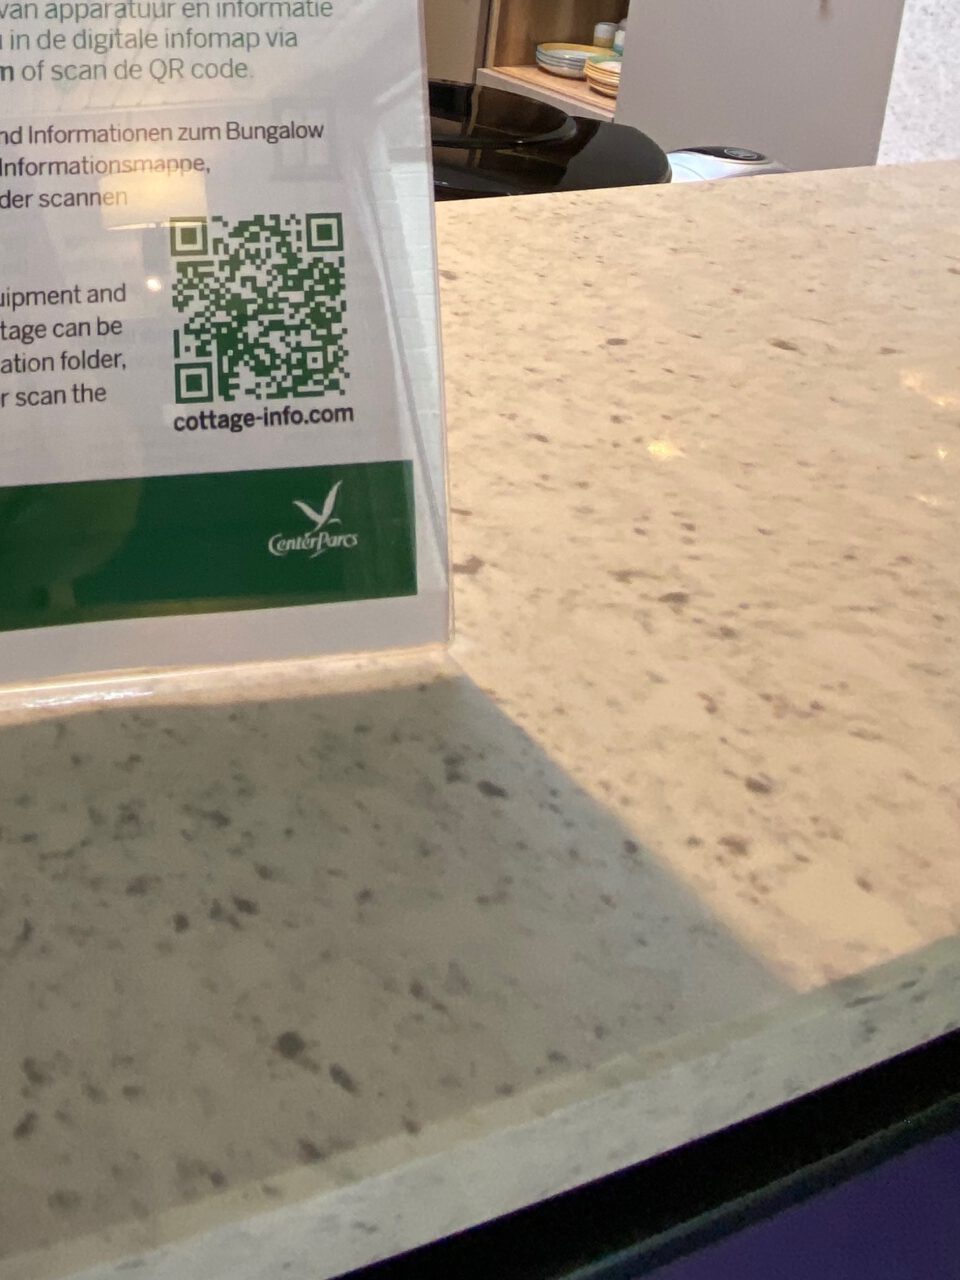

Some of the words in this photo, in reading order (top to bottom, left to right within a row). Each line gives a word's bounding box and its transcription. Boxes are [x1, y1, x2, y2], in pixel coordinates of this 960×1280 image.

[45, 0, 176, 23] apparatuur
[182, 2, 210, 18] en
[10, 29, 29, 49] in
[36, 29, 66, 49] de
[73, 29, 158, 54] digitale
[165, 28, 260, 52] infomap
[266, 28, 298, 47] via
[21, 62, 45, 82] of
[51, 63, 107, 81] scan
[114, 60, 142, 80] de
[149, 58, 184, 83] QR
[191, 59, 254, 79] code.
[29, 123, 173, 144] Informationen
[178, 124, 221, 141] zum
[227, 121, 324, 143] Bungalow
[39, 190, 127, 208] scannen
[87, 283, 126, 303] and
[53, 321, 90, 338] can
[97, 317, 122, 336] be
[60, 349, 126, 371] folder,
[15, 389, 66, 407] scan
[72, 383, 107, 404] the
[174, 406, 354, 433] cottage-info.com
